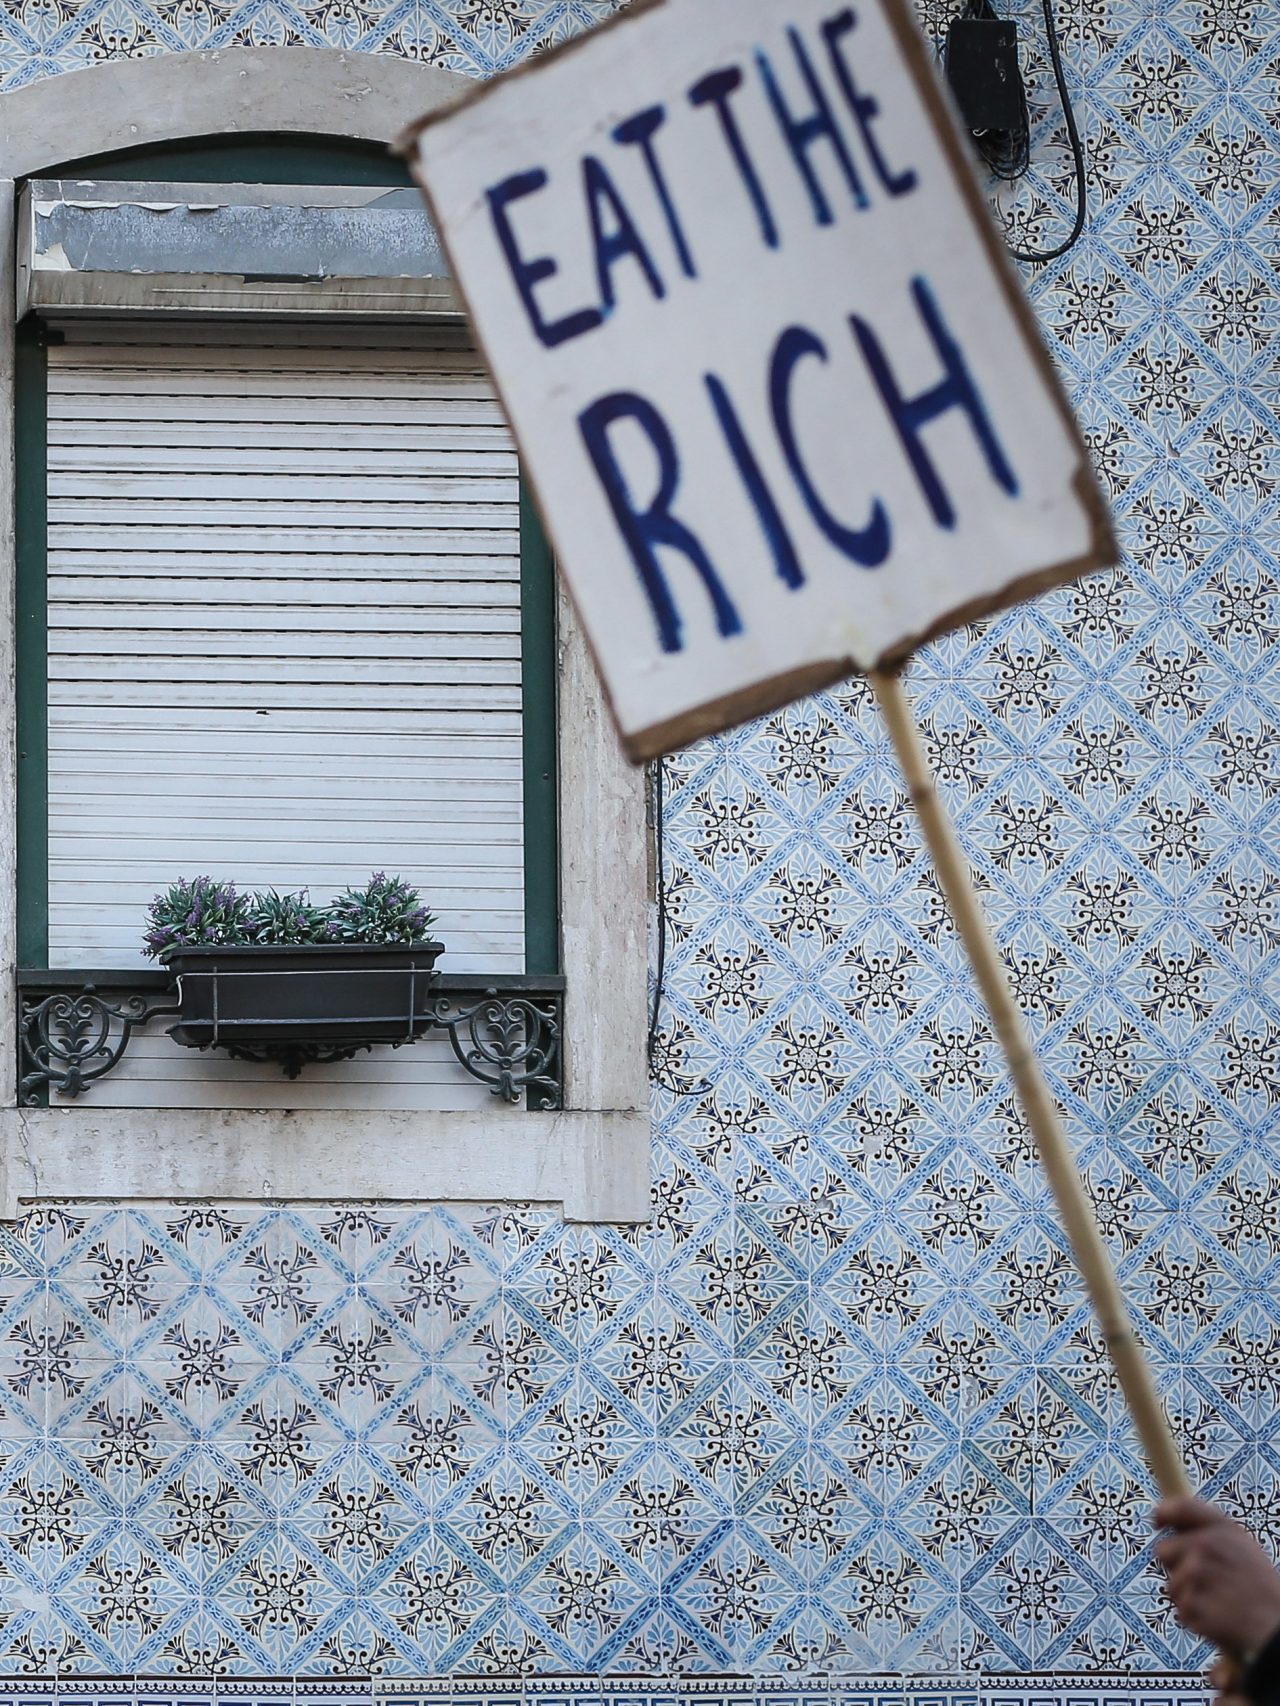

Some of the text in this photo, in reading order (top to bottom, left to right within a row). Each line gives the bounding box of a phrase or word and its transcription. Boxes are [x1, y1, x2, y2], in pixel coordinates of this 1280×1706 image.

[484, 9, 920, 350] EAT THE
[575, 272, 1022, 656] RICH
